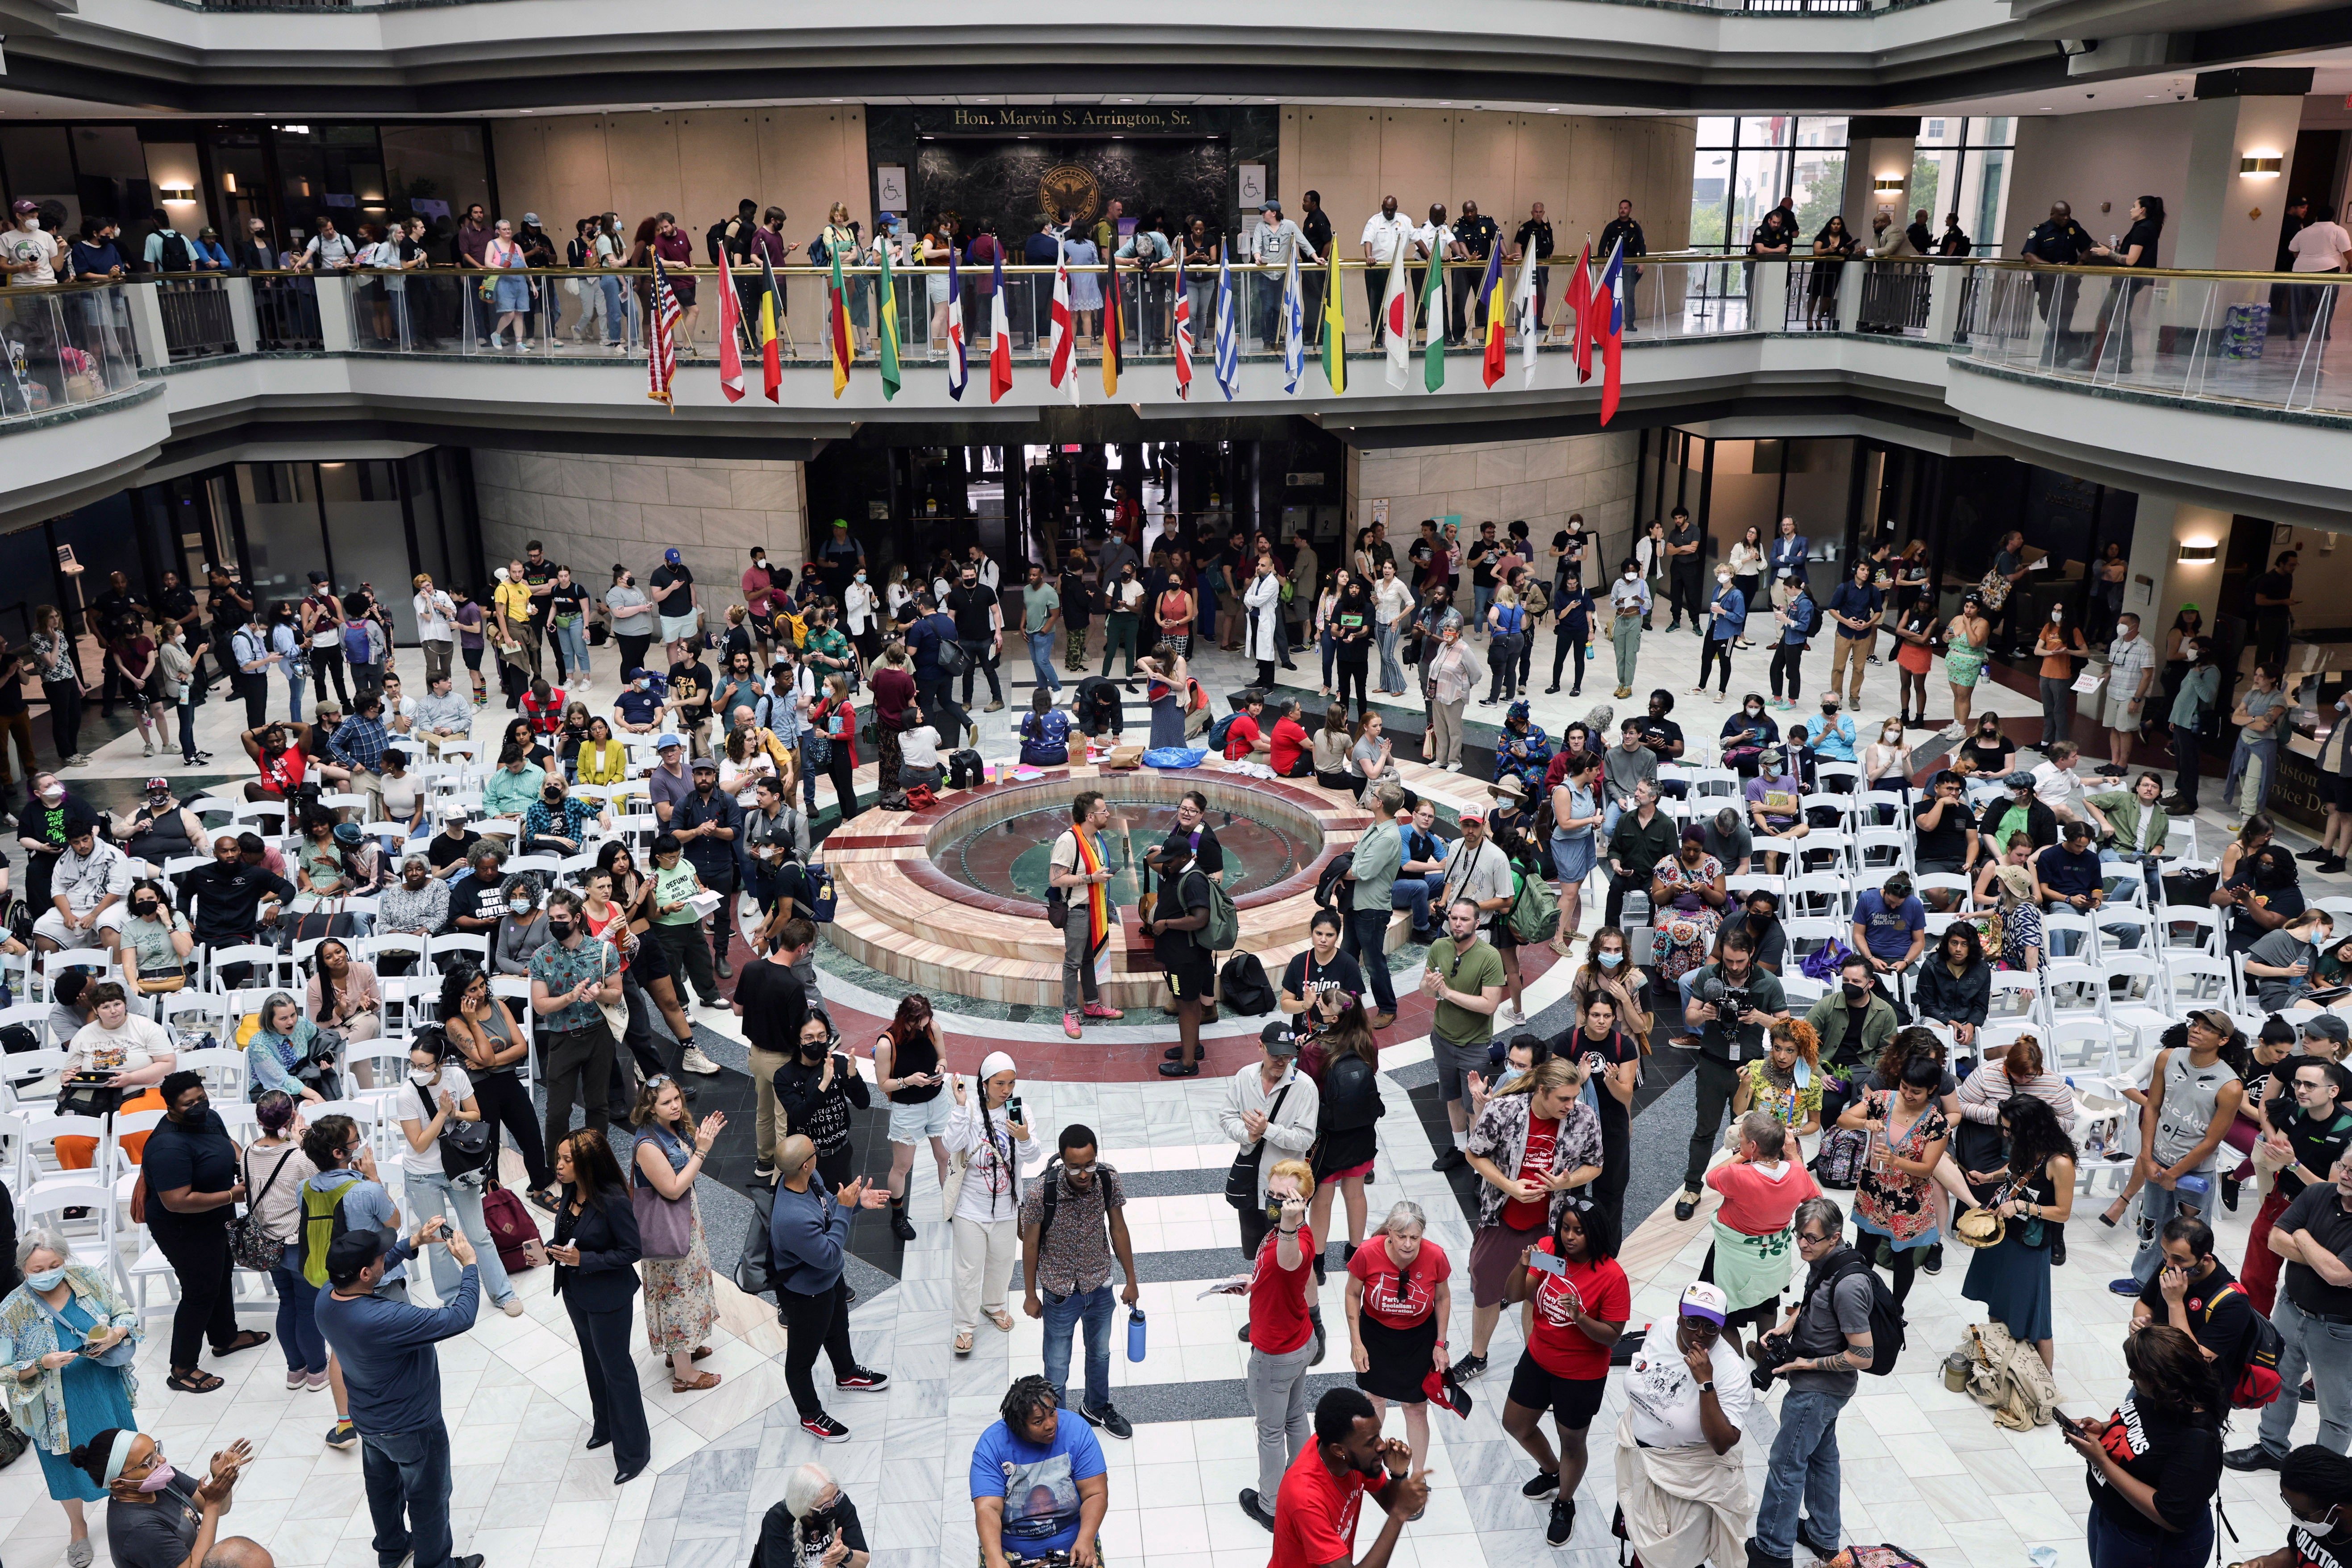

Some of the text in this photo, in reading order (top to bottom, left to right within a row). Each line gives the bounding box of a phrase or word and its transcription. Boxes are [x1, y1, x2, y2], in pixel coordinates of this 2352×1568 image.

[955, 110, 1194, 128] Hon. Marvin S. Arrington, Sr.
[666, 875, 688, 890] DEFUND
[480, 887, 500, 898] NEED
[671, 890, 686, 900] BUILD
[1872, 913, 1887, 921] Taking
[1171, 974, 1180, 995] PUMA
[1544, 1292, 1557, 1305] Party
[1543, 1299, 1565, 1315] Socialism
[1543, 1306, 1566, 1322] Liberation
[2117, 1398, 2150, 1455] SOLUTIONS
[805, 1543, 822, 1552] COP
